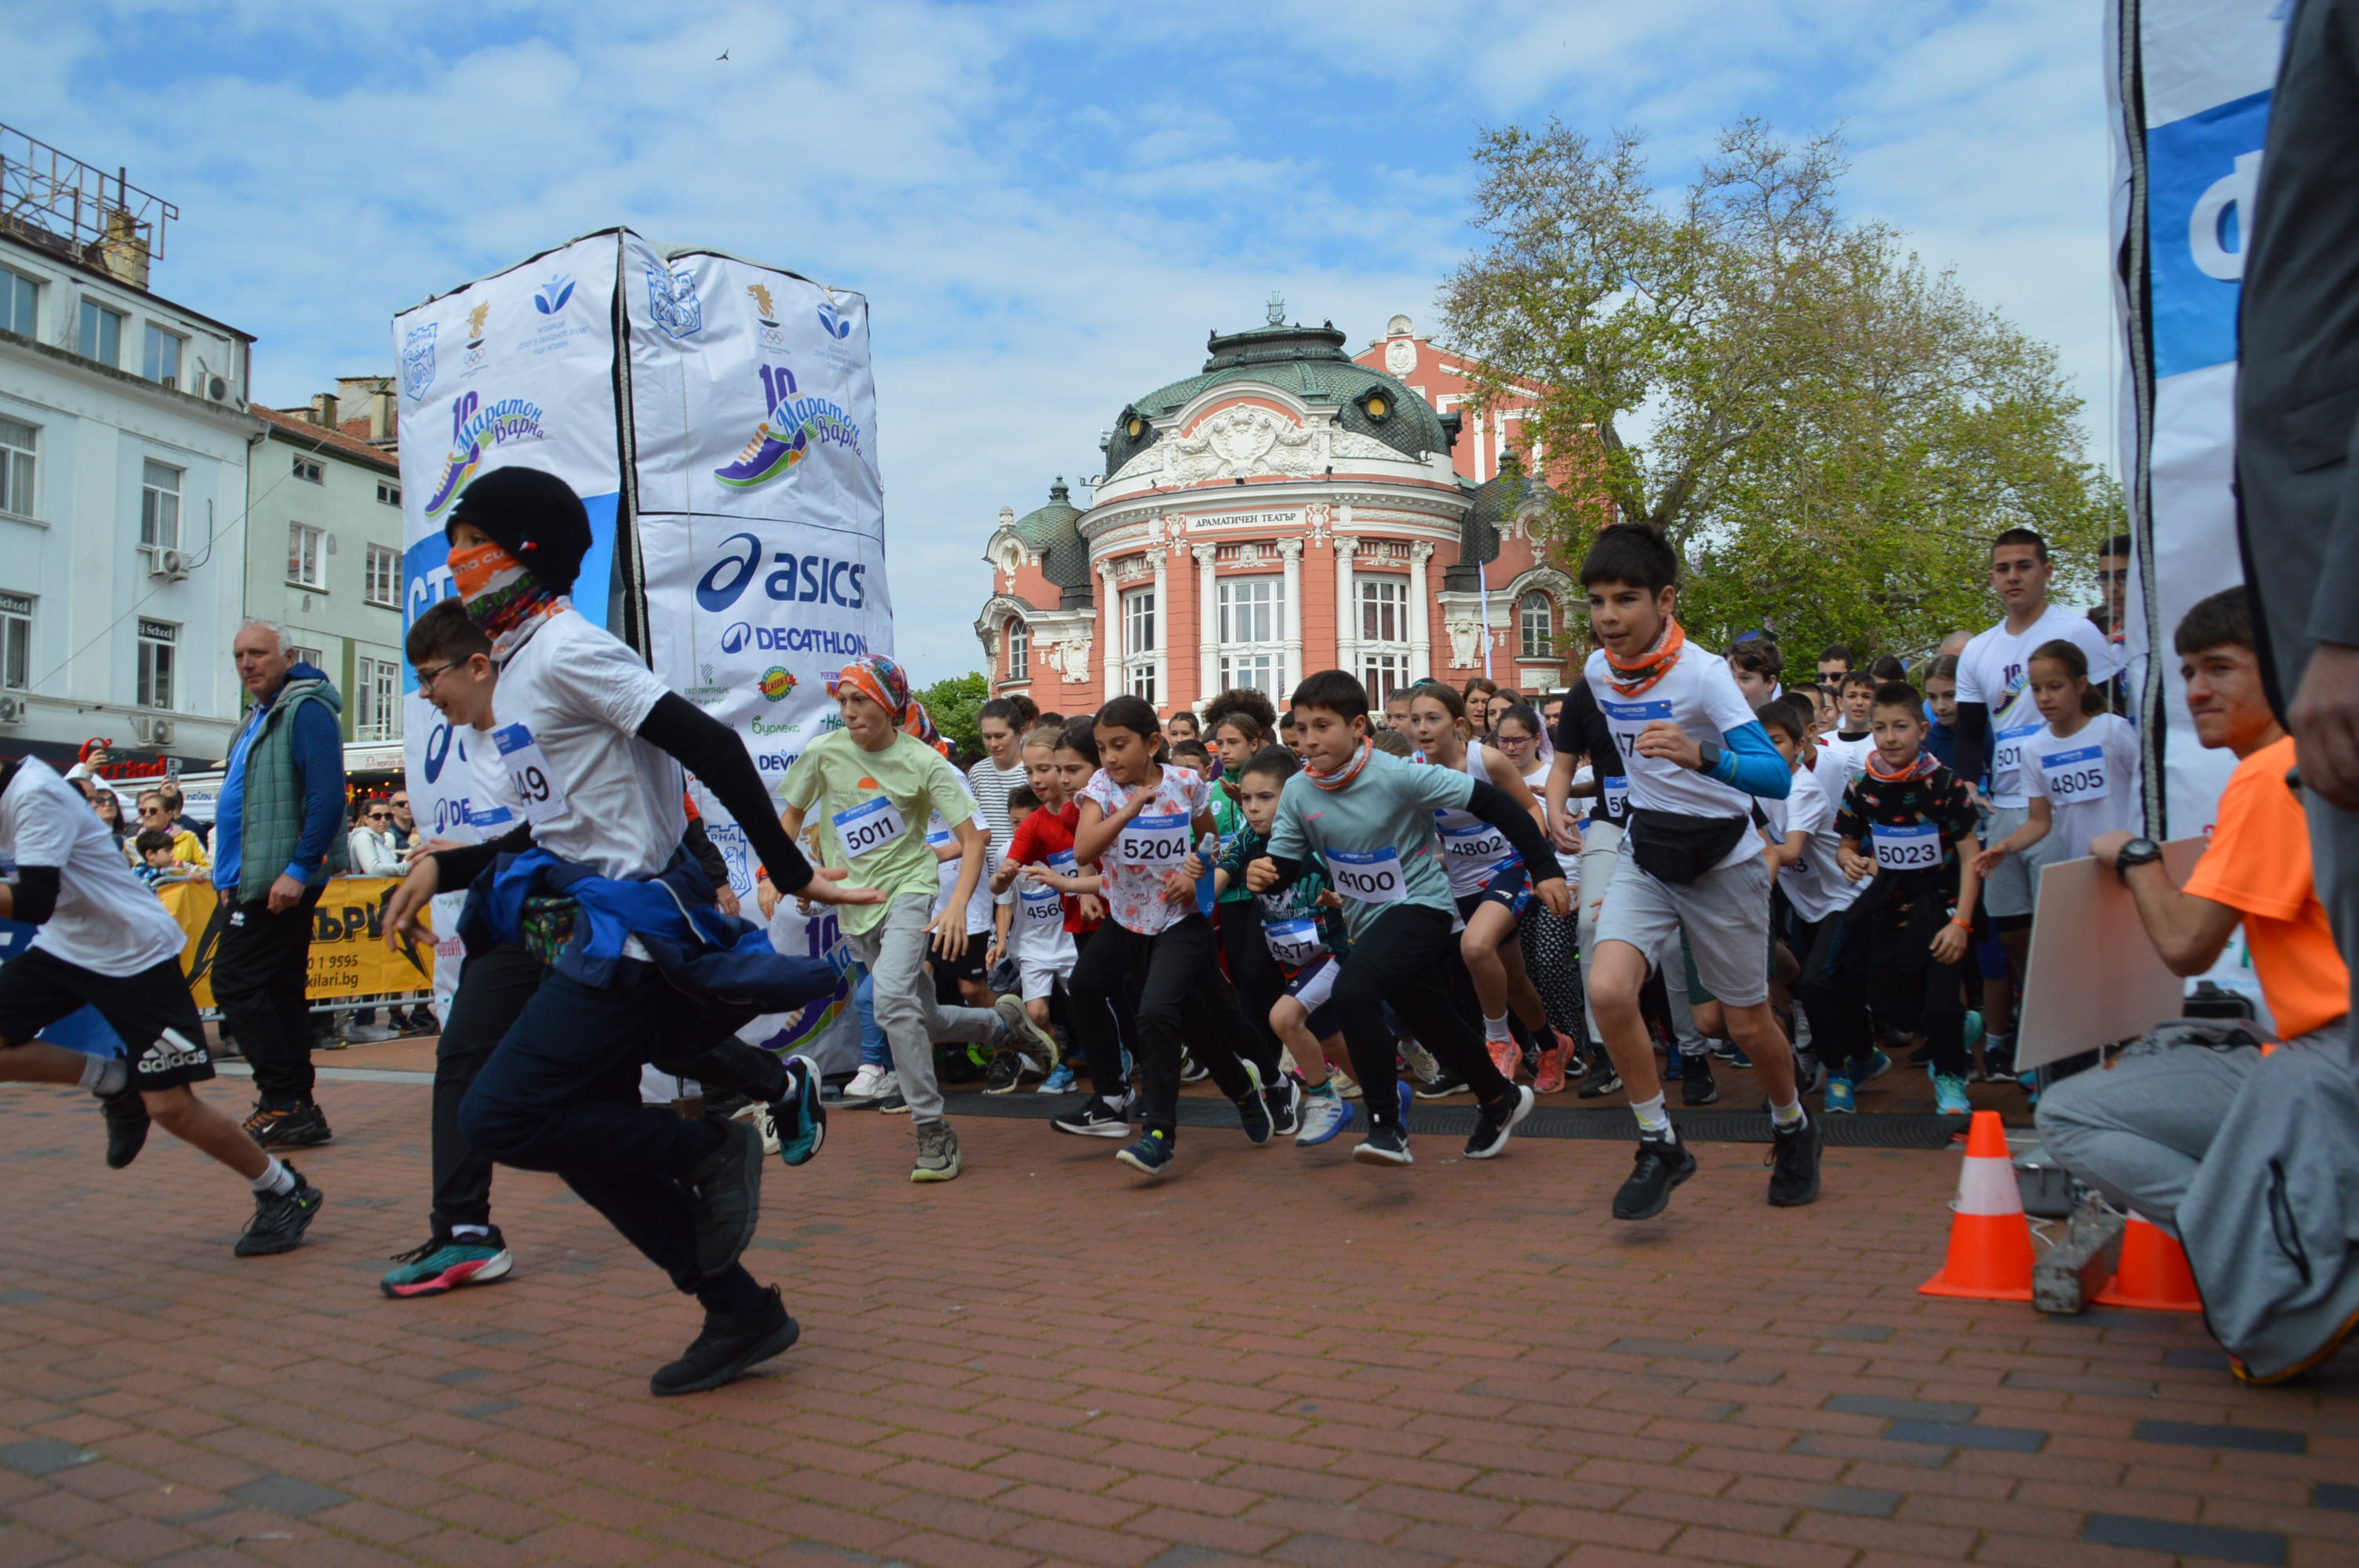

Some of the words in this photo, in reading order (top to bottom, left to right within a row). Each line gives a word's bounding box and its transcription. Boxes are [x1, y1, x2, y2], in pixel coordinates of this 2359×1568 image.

[758, 363, 798, 420] 10
[452, 390, 478, 448] 10
[457, 398, 543, 454] Маратон
[776, 397, 860, 439] Маратон
[491, 417, 546, 445] Варна
[815, 416, 862, 457] Варна
[1195, 514, 1258, 528] ДРАМАТИЧЕН
[1262, 513, 1296, 523] ТЕАТЪР
[146, 625, 173, 639] School
[756, 627, 867, 656] DECATHLON
[1997, 746, 2021, 768] 501
[511, 766, 550, 806] 49
[2052, 768, 2104, 795] 4805
[846, 817, 895, 851] 5011
[1452, 836, 1503, 856] 4802
[1123, 837, 1186, 860] 5204
[1878, 844, 1936, 865] 5023
[1338, 870, 1394, 893] 4100
[329, 954, 358, 969] 9595
[1273, 939, 1314, 959] 4377
[137, 1049, 208, 1073] adidas
